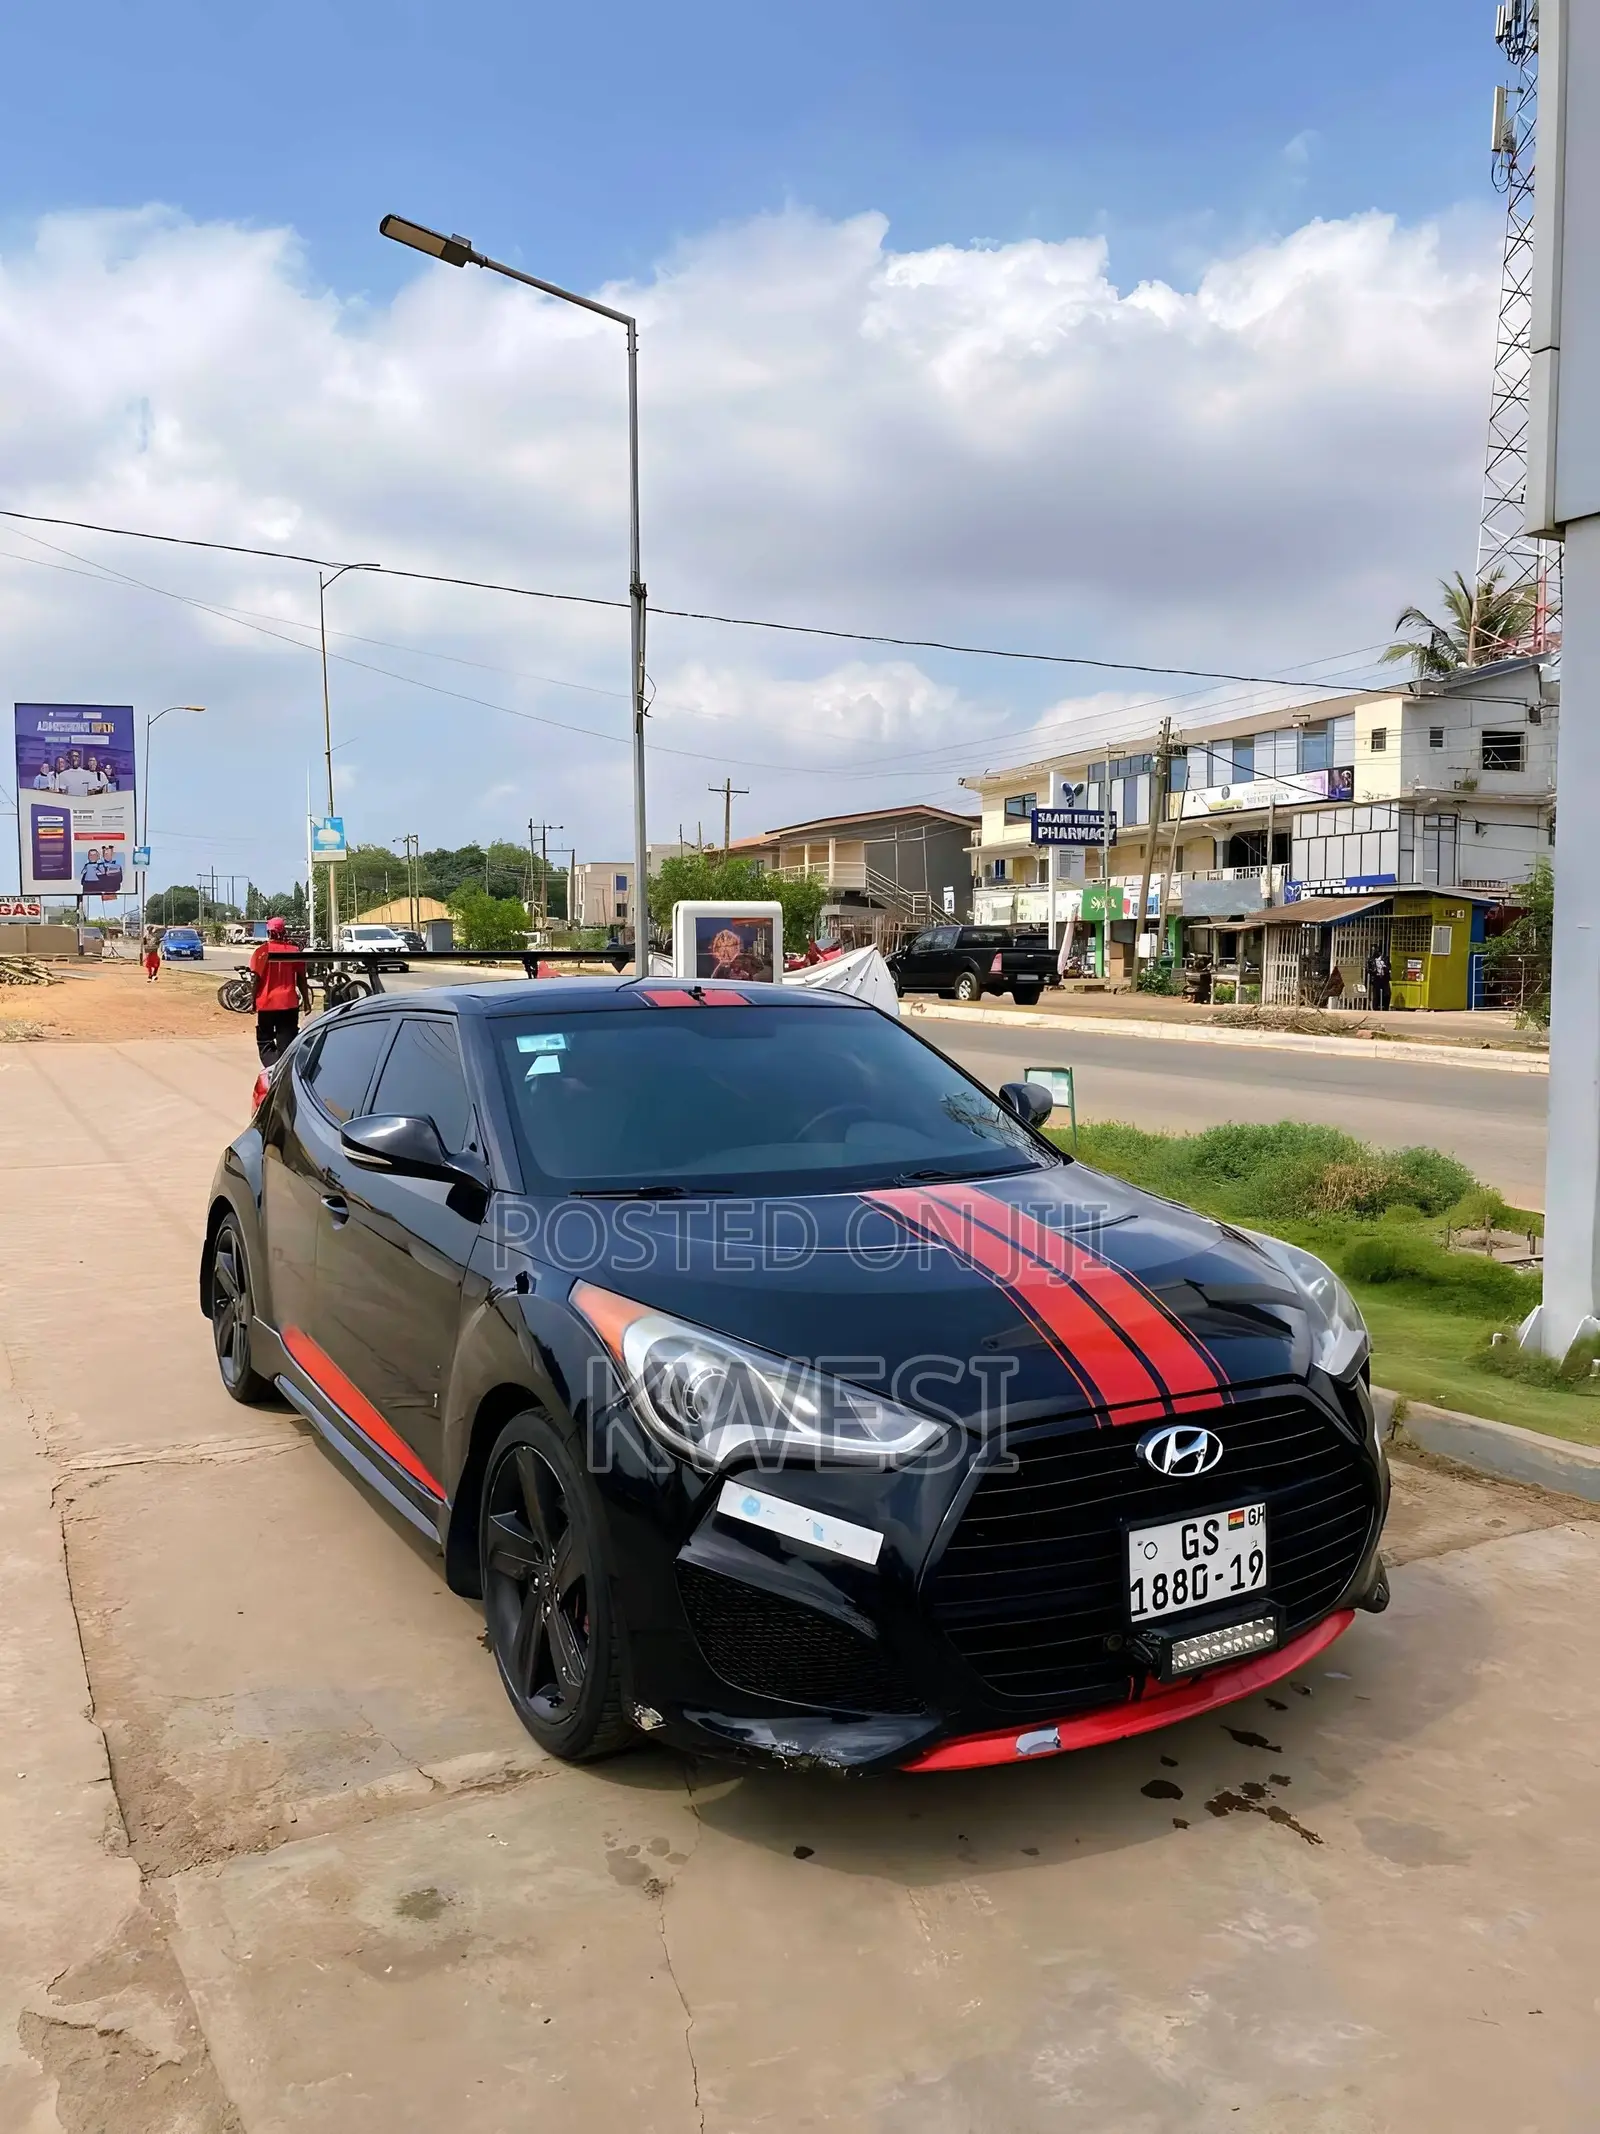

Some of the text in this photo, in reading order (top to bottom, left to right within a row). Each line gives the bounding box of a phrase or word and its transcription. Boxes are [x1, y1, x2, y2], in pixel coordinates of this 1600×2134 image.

[0, 903, 40, 916] GAS
[1181, 1519, 1220, 1561] GS
[1131, 1549, 1264, 1616] 1880-19
